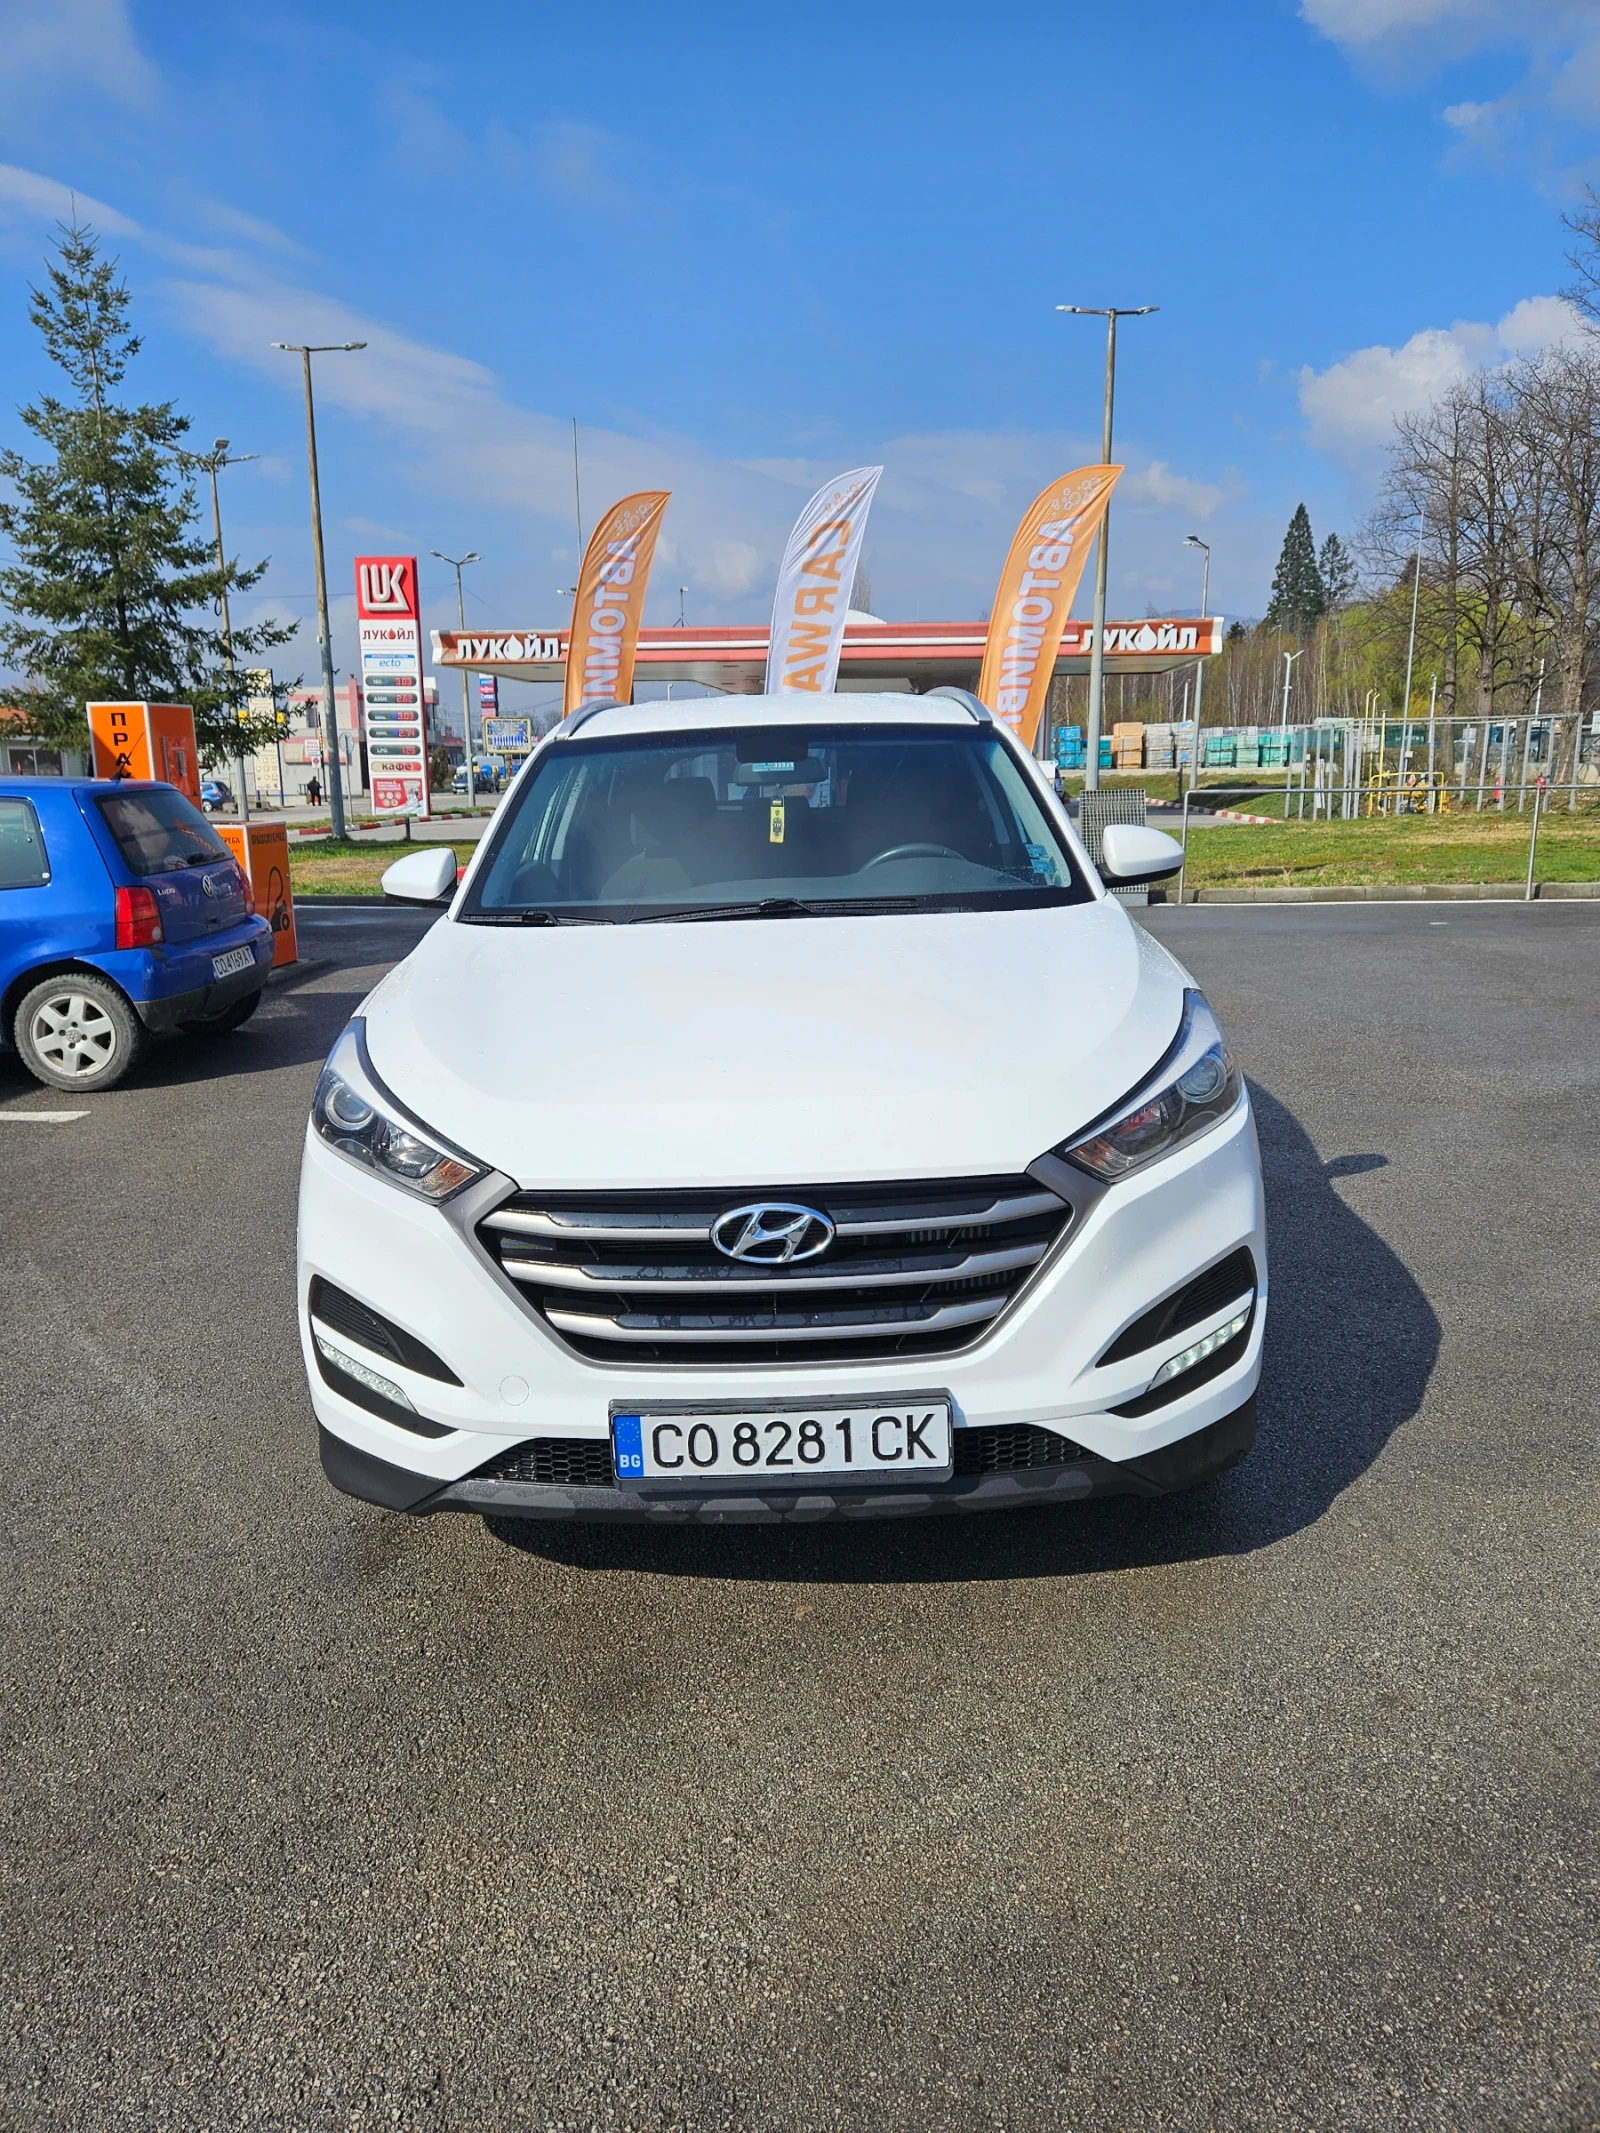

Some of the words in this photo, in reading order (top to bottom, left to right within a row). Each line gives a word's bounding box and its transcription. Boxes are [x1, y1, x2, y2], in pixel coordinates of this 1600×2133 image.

[362, 627, 415, 640] ЛУКОЙЛ
[455, 633, 559, 660] ЛУКОЙЛ
[379, 658, 401, 667] ecto
[382, 763, 412, 772] кафе
[157, 886, 176, 896] Lupo
[732, 1416, 853, 1467] 8281
[619, 1453, 642, 1469] BG
